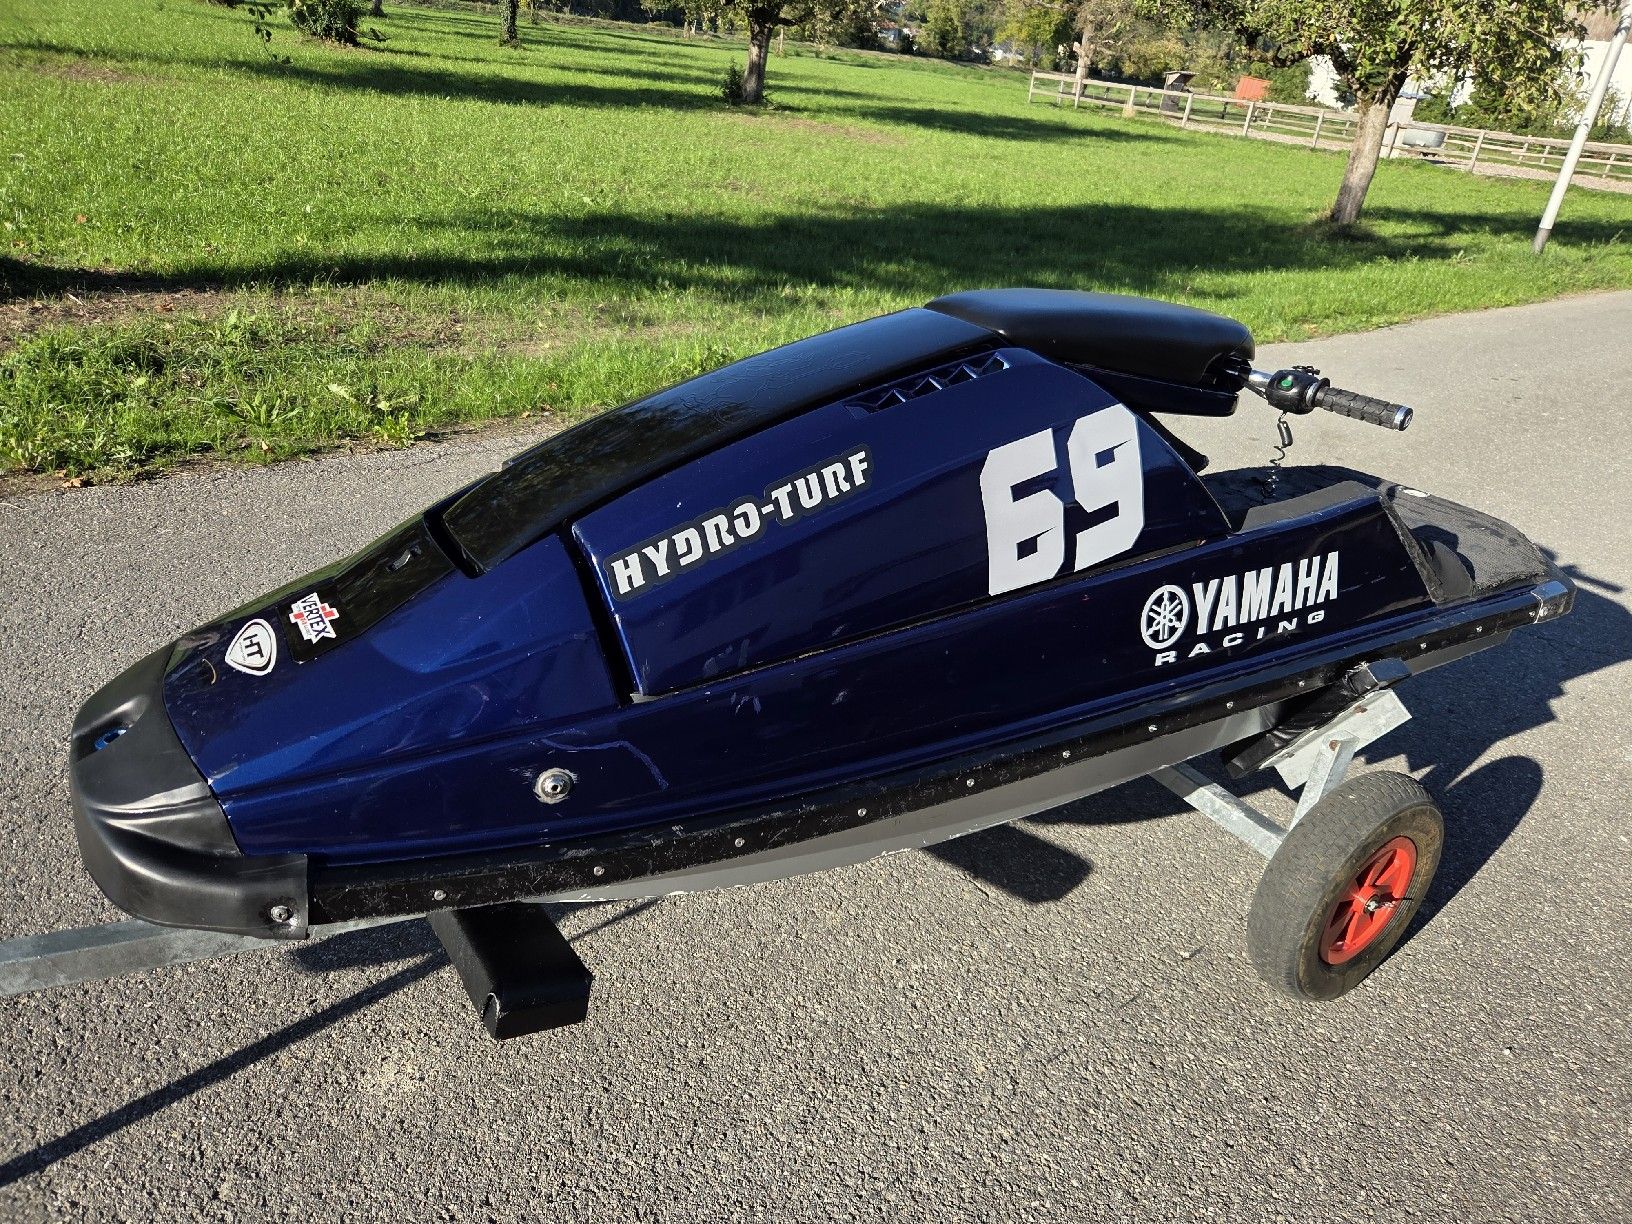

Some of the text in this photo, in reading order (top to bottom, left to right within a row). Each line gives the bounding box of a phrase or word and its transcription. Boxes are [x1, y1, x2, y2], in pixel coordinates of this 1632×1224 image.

[611, 450, 869, 595] HYDRO-TURF
[979, 403, 1145, 597] 69
[300, 594, 331, 639] VERTEX
[1192, 550, 1339, 636] YAMAHA
[243, 633, 265, 659] HT
[1154, 609, 1325, 667] RACING
